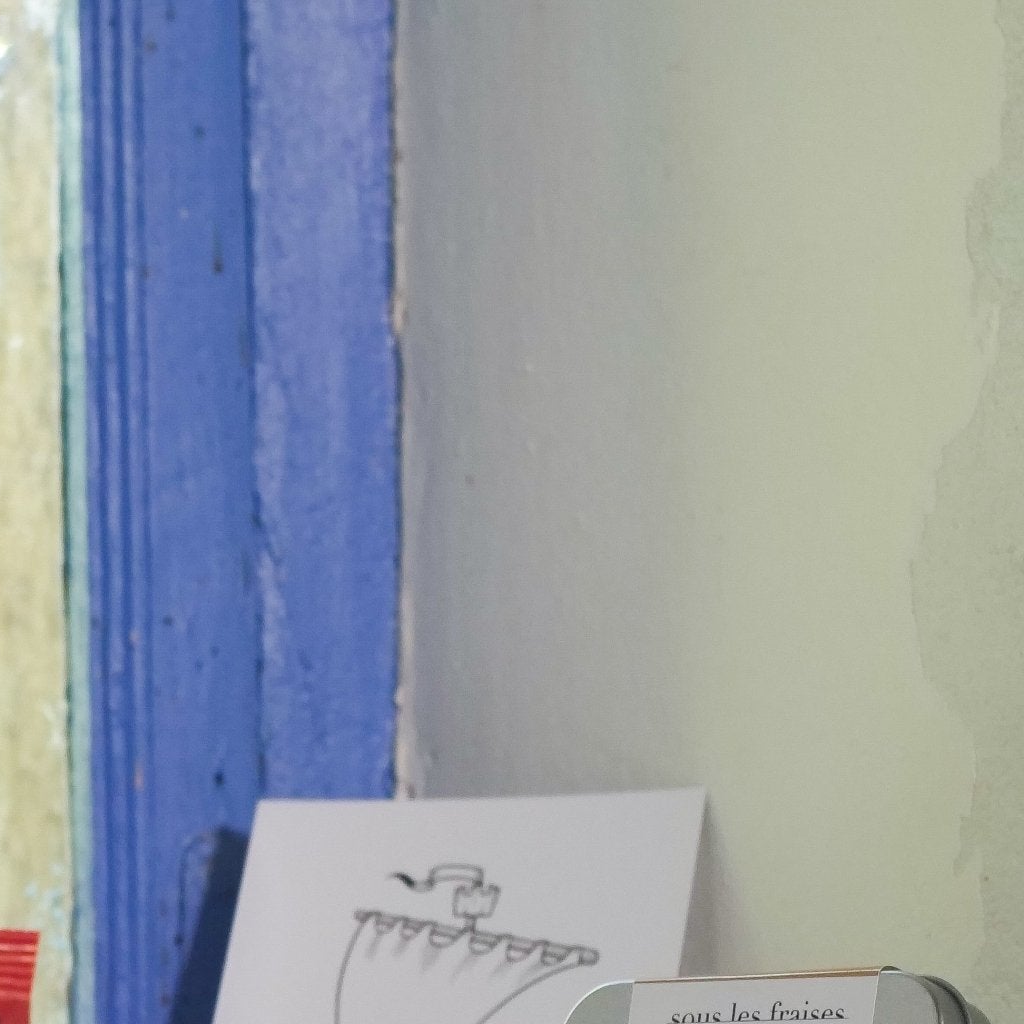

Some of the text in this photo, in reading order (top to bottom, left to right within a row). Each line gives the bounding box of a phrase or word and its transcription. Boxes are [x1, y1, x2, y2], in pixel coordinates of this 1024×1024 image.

[671, 1001, 845, 1024] sous les fraises
